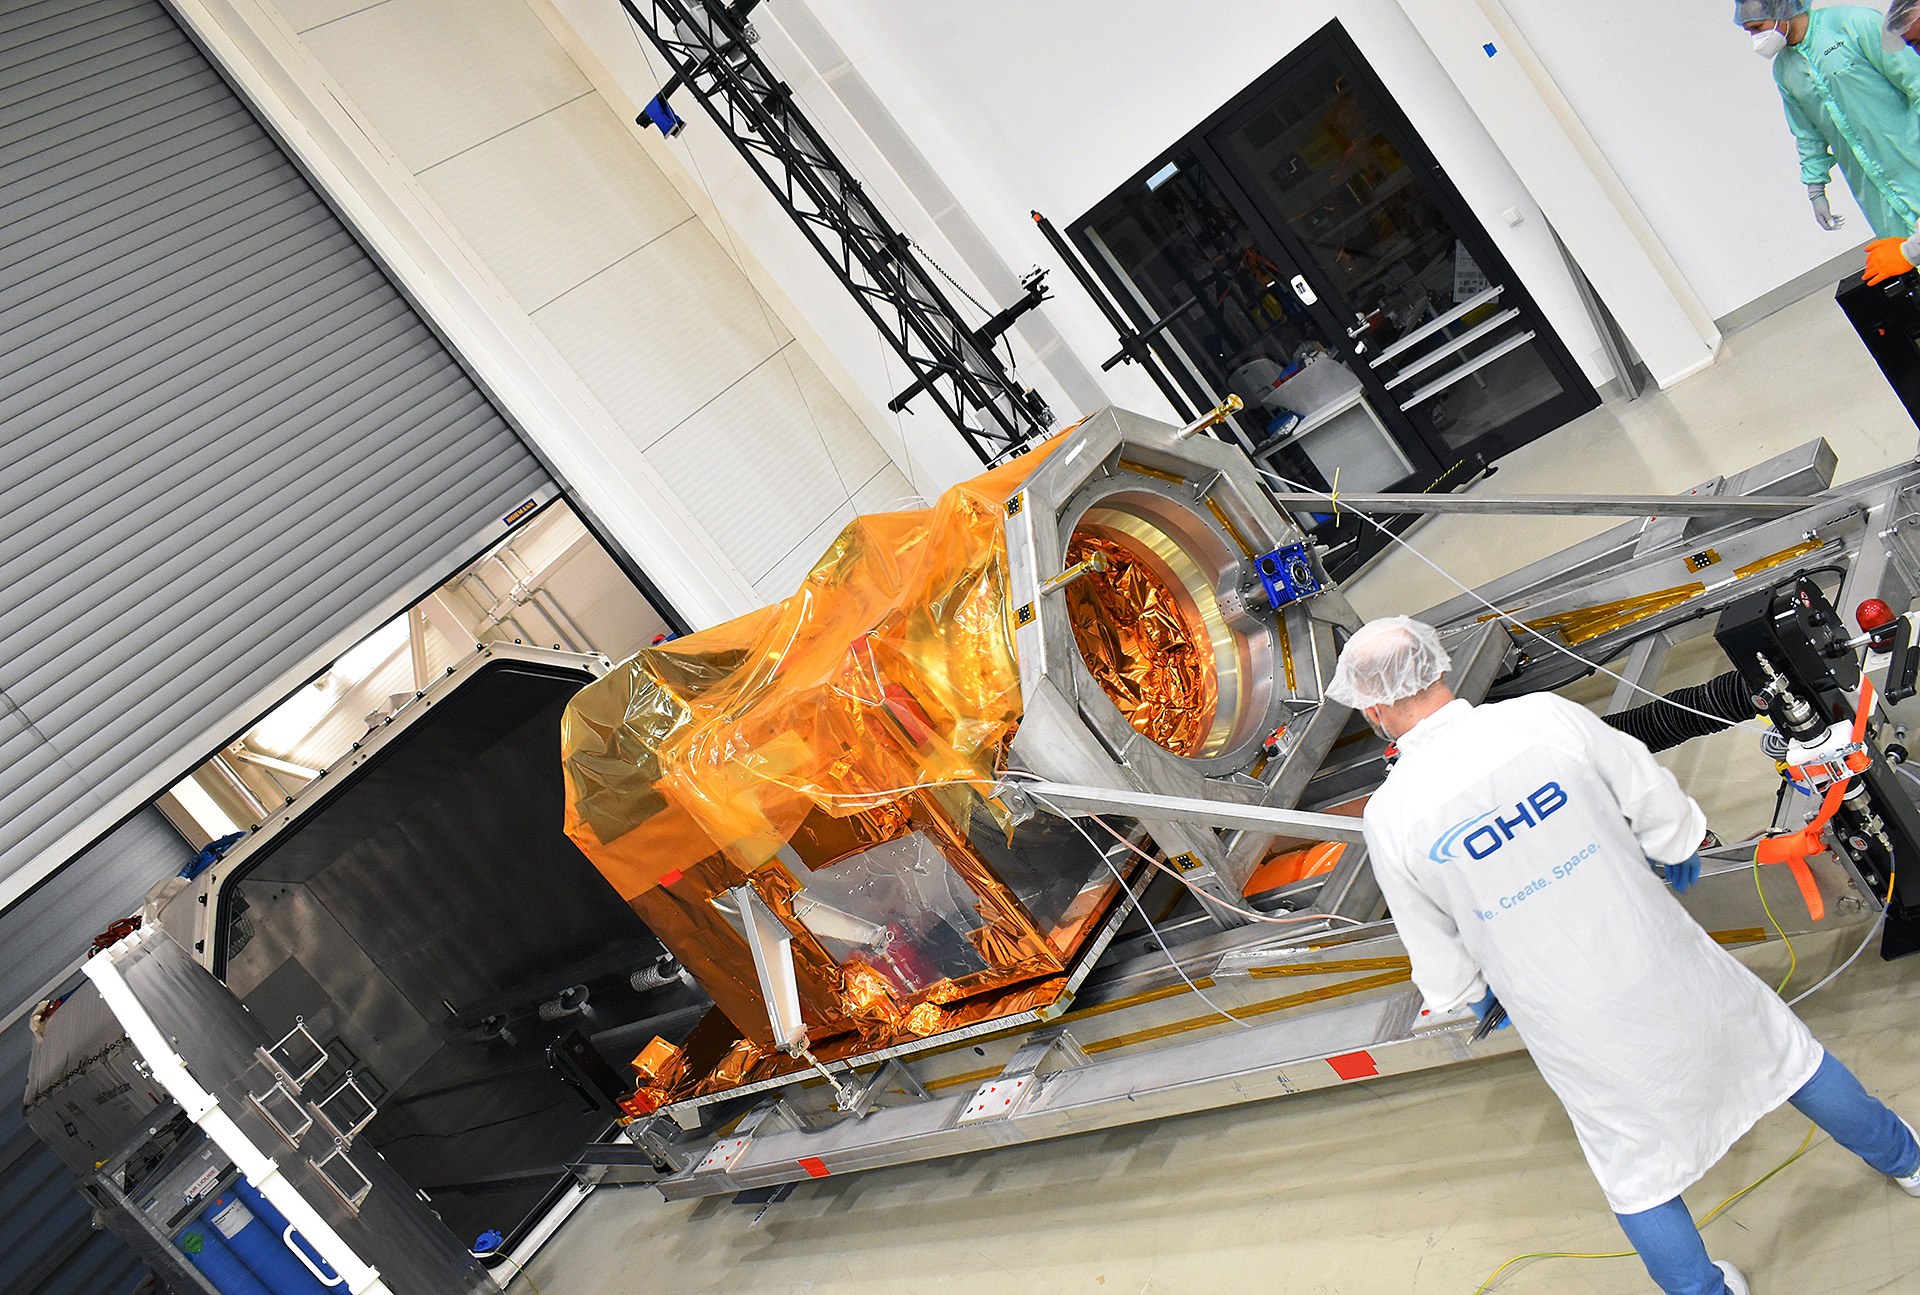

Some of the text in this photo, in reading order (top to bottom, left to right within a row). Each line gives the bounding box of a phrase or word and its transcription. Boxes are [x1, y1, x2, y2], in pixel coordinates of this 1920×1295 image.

[1823, 40, 1845, 56] QUALITY
[1462, 781, 1568, 861] OHB
[1499, 877, 1552, 910] Create.
[1552, 843, 1601, 880] Space.
